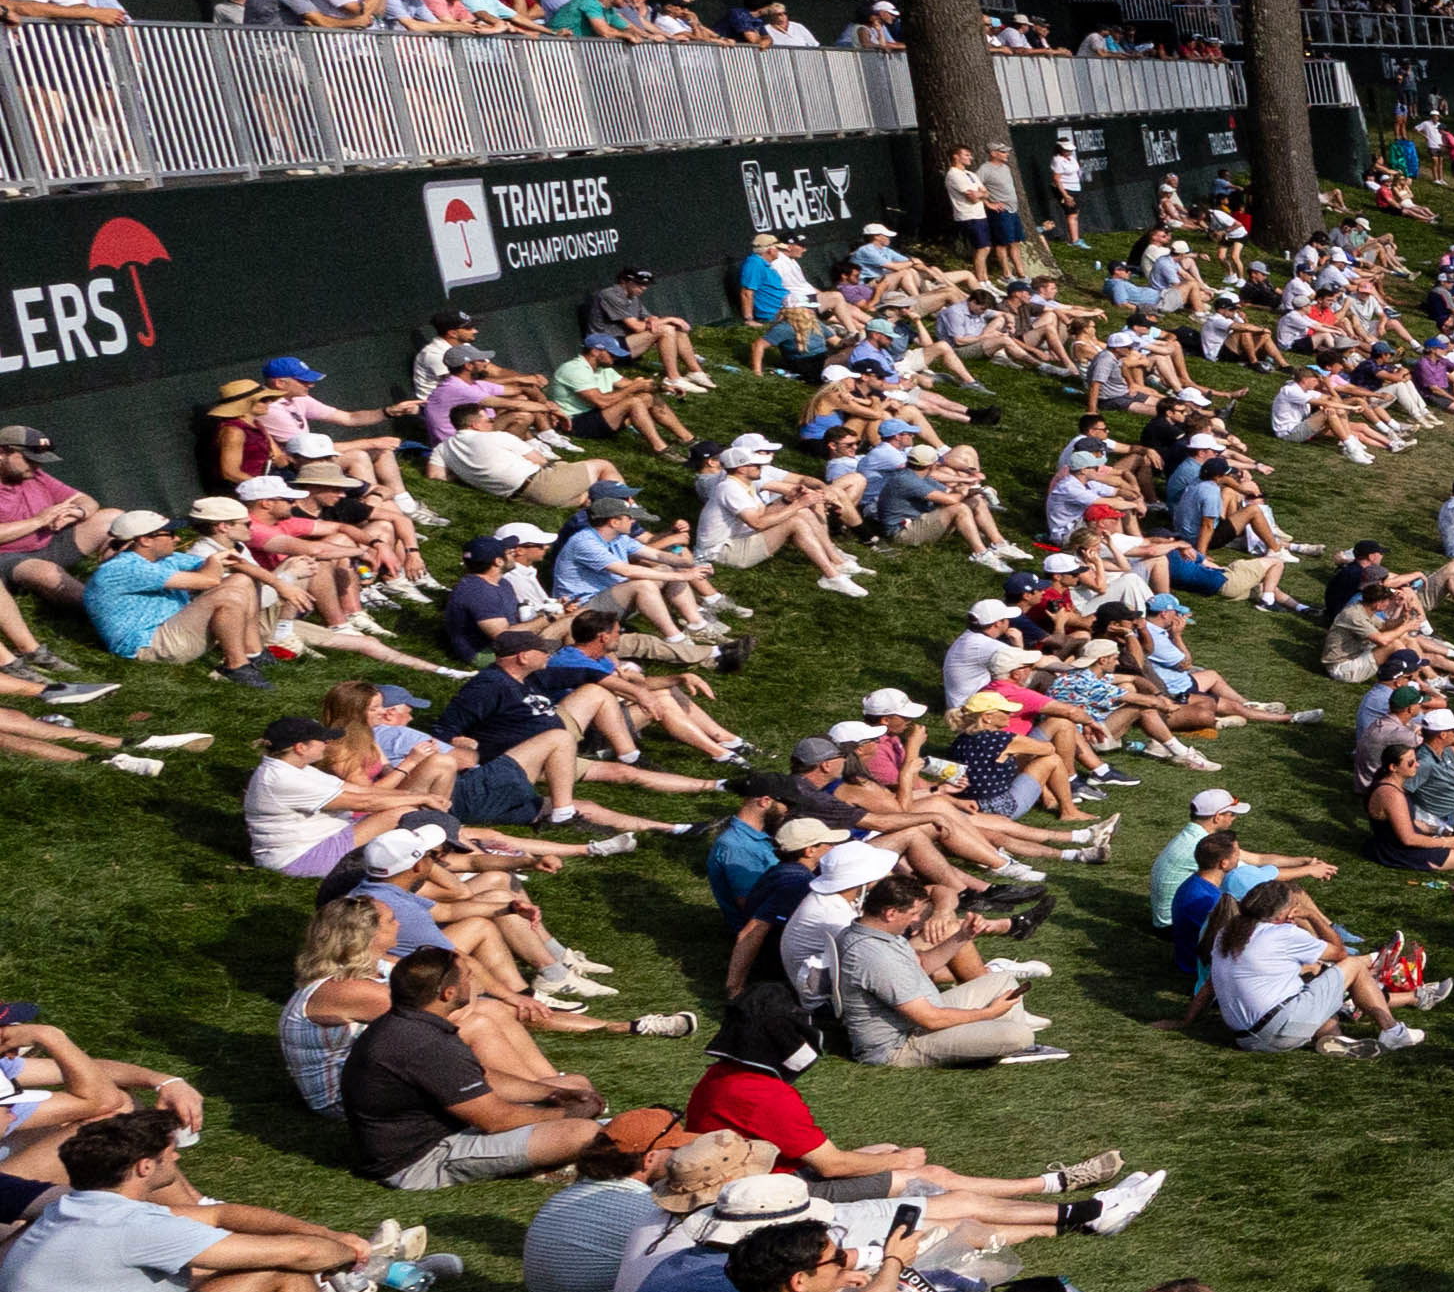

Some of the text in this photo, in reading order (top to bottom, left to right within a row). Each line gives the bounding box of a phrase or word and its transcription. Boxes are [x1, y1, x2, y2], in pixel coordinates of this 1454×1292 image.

[492, 176, 612, 228] TRAVELERS
[765, 168, 834, 231] FedEx
[506, 228, 619, 269] CHAMPIONSHIP
